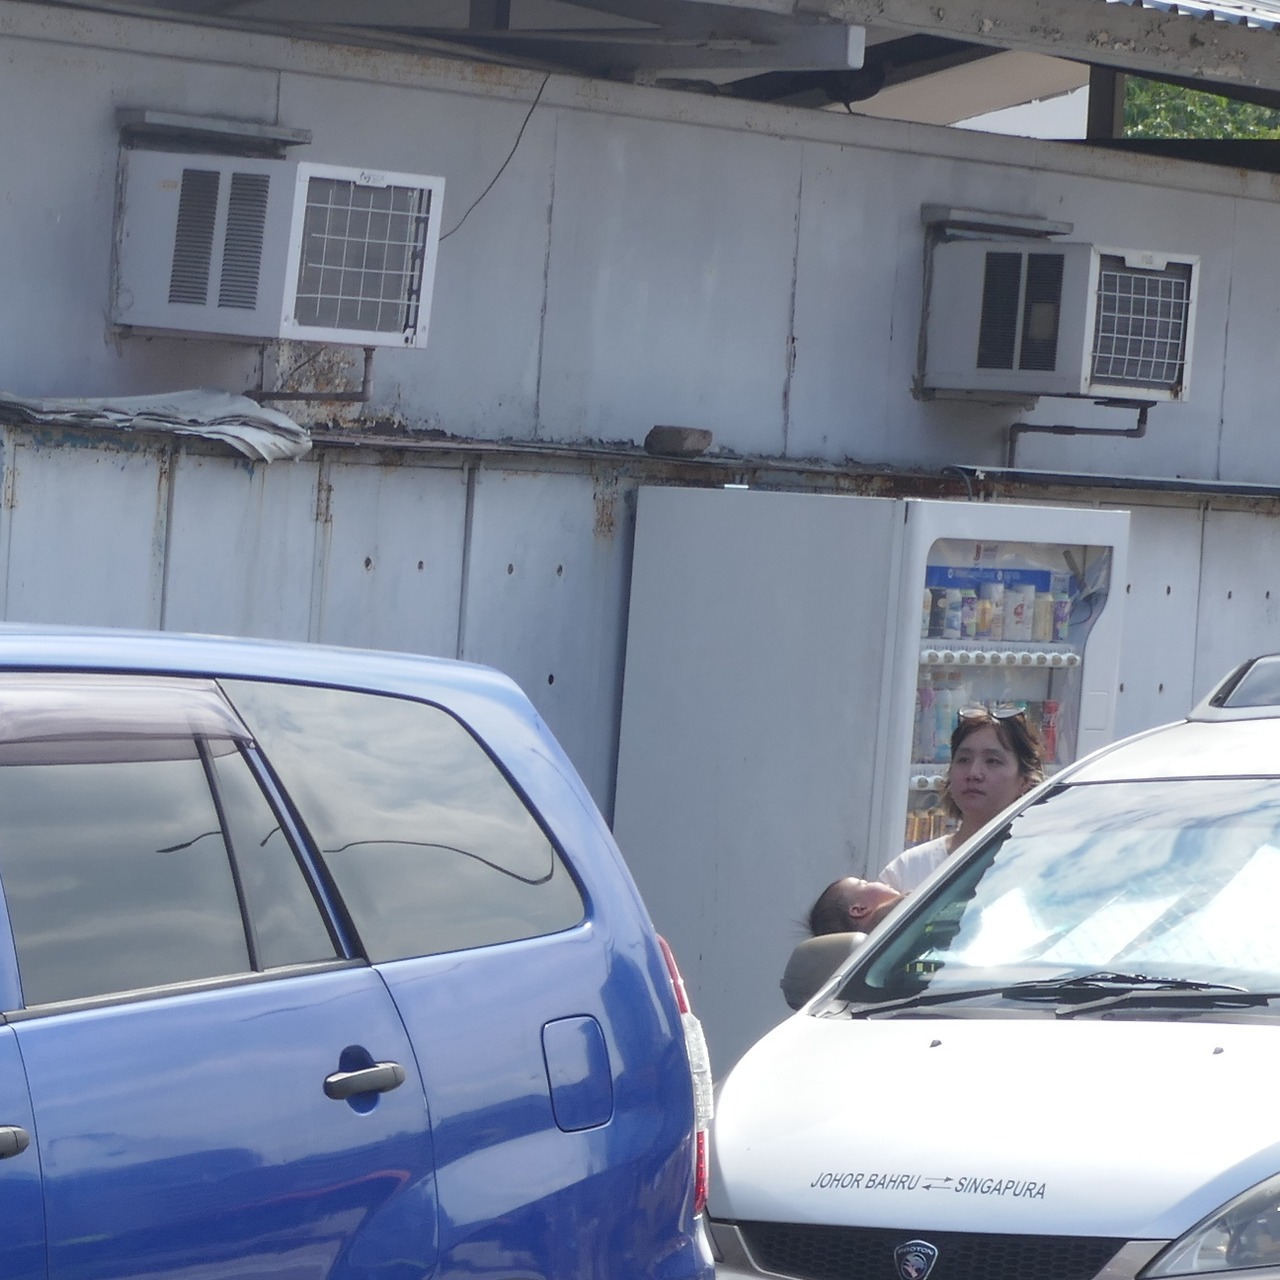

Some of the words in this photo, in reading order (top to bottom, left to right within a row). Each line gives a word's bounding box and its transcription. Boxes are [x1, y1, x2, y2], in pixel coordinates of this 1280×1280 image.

[810, 1172, 865, 1189] JOHOR
[864, 1173, 922, 1191] BAHRU
[954, 1177, 1047, 1199] SINGAPURA
